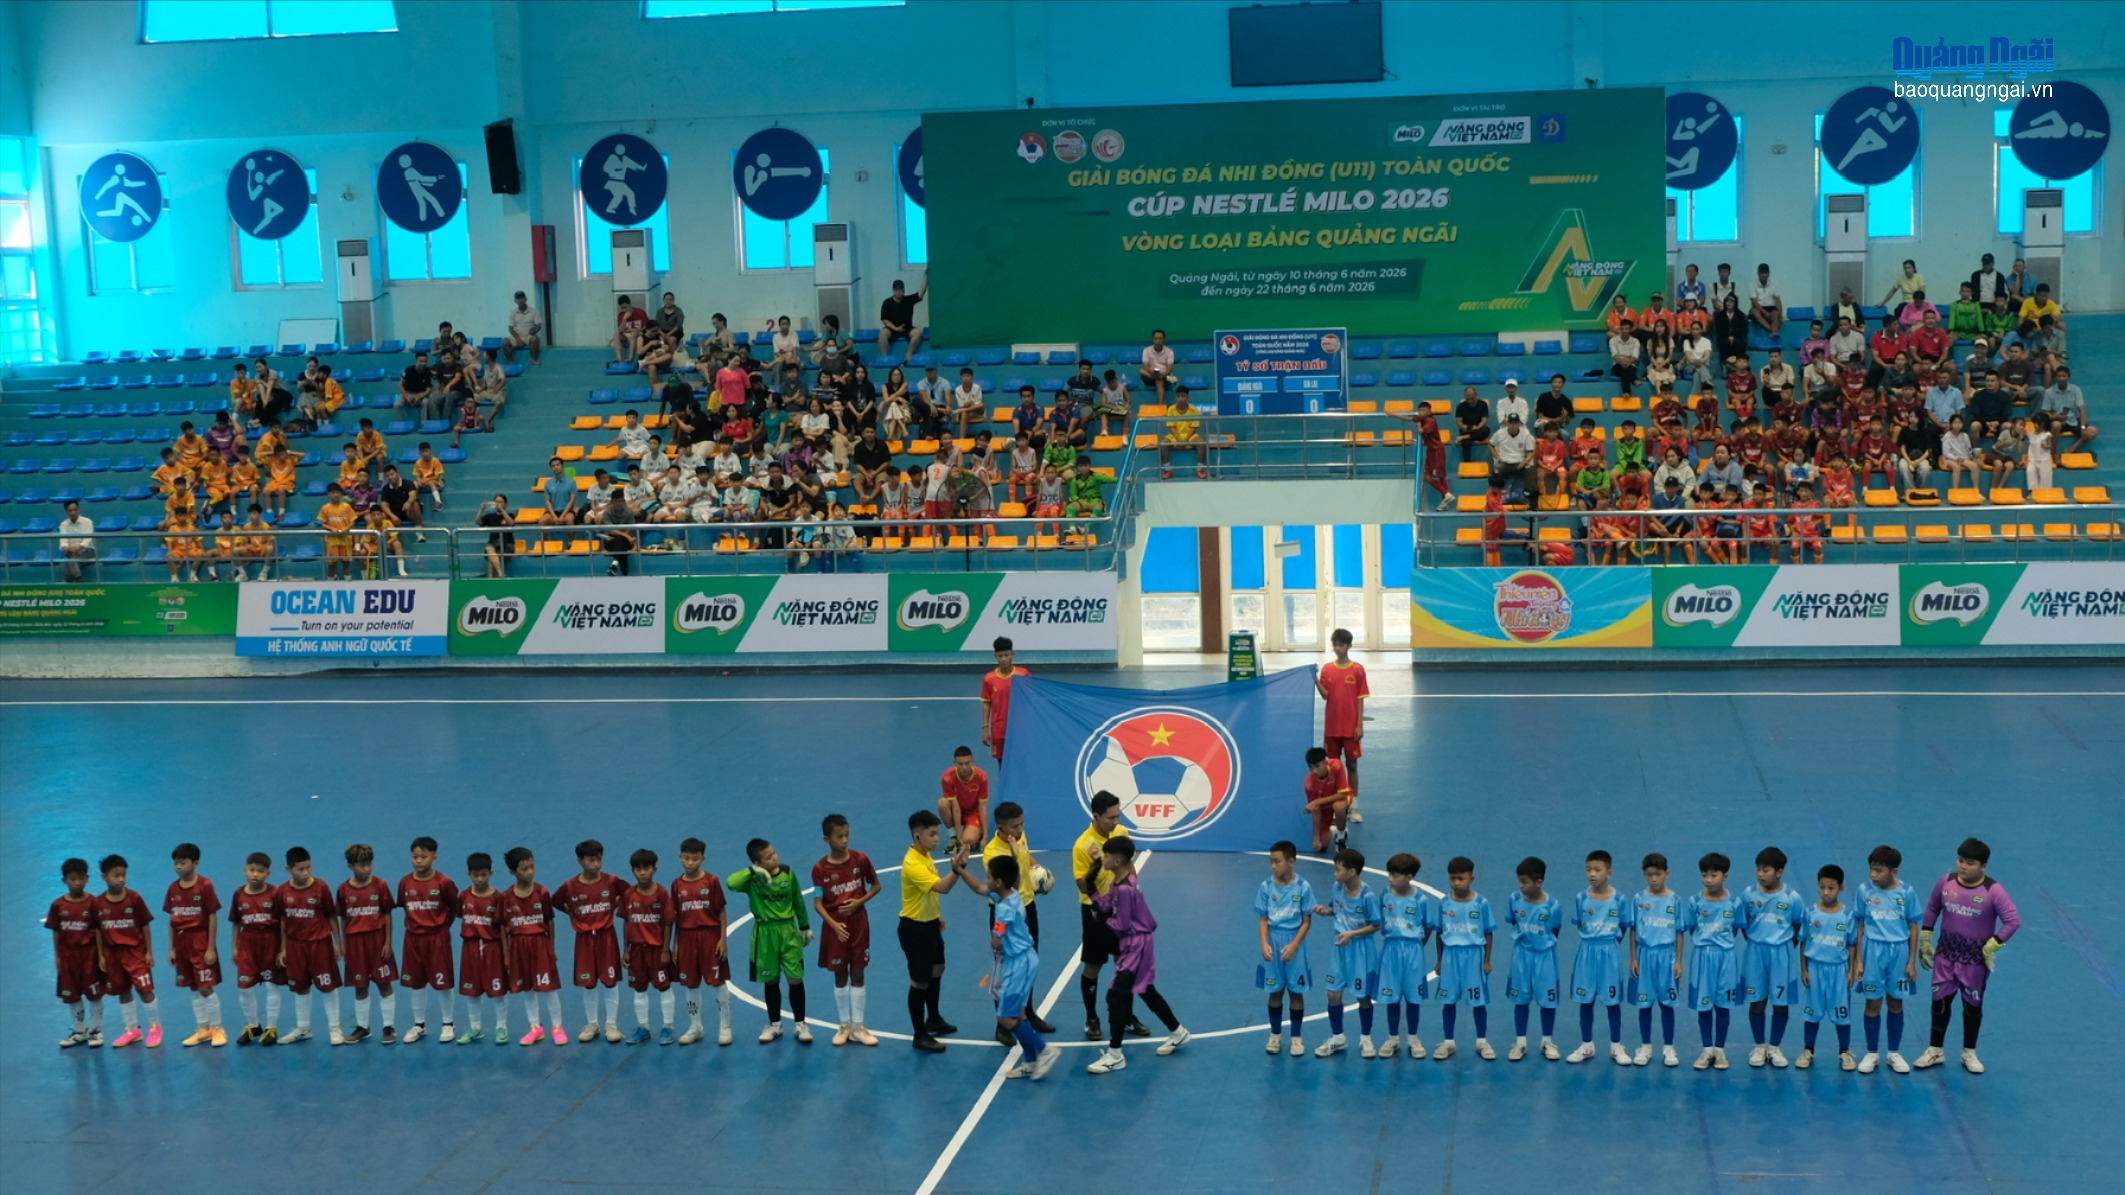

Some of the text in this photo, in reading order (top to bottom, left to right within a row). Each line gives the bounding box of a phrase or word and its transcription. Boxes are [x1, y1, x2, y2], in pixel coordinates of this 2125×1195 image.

[1397, 129, 1421, 140] MILO
[1480, 132, 1510, 142] NAM
[1067, 152, 1511, 187] GIẢI BÓNG ĐÁ NHI ĐỒNG (U11) TOÀN QUỐC
[1127, 186, 1451, 217] CÚP NESTLÉ MILO 2026
[1121, 221, 1458, 252] VÒNG LOẠI BẢNG QUẢNG NGÃI
[1169, 267, 1407, 285] Quảng Ngãi, từ ngày 10 tháng 6 năm 2026
[1200, 282, 1376, 298] đến ngày 22 tháng 6 năm 2026
[766, 319, 775, 332] 2
[1235, 359, 1250, 371] TỶ
[1252, 358, 1269, 371] SỐ
[1270, 359, 1300, 372] TRẬN
[1245, 398, 1318, 414] 0 0
[4, 598, 38, 607] NESTLÉ
[39, 599, 63, 607] MILO
[63, 598, 86, 607] 2026
[270, 589, 416, 615] OCEAN EDU
[1673, 595, 1733, 614] MILO
[1771, 590, 1831, 612] NĂNG
[1921, 593, 1981, 612] MILO
[2020, 588, 2125, 609] NĂNG ĐỘN
[553, 602, 604, 623] NĂNG
[684, 604, 738, 622] MILO
[772, 599, 826, 620] NĂNG
[907, 601, 963, 619] MILO
[998, 596, 1053, 618] NĂNG
[1780, 603, 1867, 621] VIỆT NAM
[2029, 602, 2118, 619] VIỆT NAM
[467, 607, 520, 625] MILO
[560, 614, 637, 630] VIỆT NAM
[780, 612, 860, 627] VIỆT NAM
[1006, 608, 1087, 626] VIỆT NAM
[301, 620, 322, 631] Turn
[340, 623, 364, 633] your
[366, 620, 414, 632] potential
[267, 636, 414, 655] HỆ THỐNG ANH NGỮ QUỐC TẾ
[1135, 804, 1175, 818] VFF
[198, 969, 213, 982] 12
[378, 964, 391, 978] 10
[436, 972, 445, 985] 2
[536, 972, 551, 986] 14
[608, 966, 616, 979] 9
[712, 966, 720, 979] 7
[317, 973, 332, 986] 18
[491, 978, 502, 991] 5
[1297, 974, 1306, 987] 4
[1355, 978, 1363, 991] 8
[1467, 986, 1481, 1001] 18
[1547, 988, 1556, 1002] 5
[1608, 984, 1617, 999] 9
[1776, 984, 1785, 1000] 7
[1834, 1005, 1849, 1020] 19
